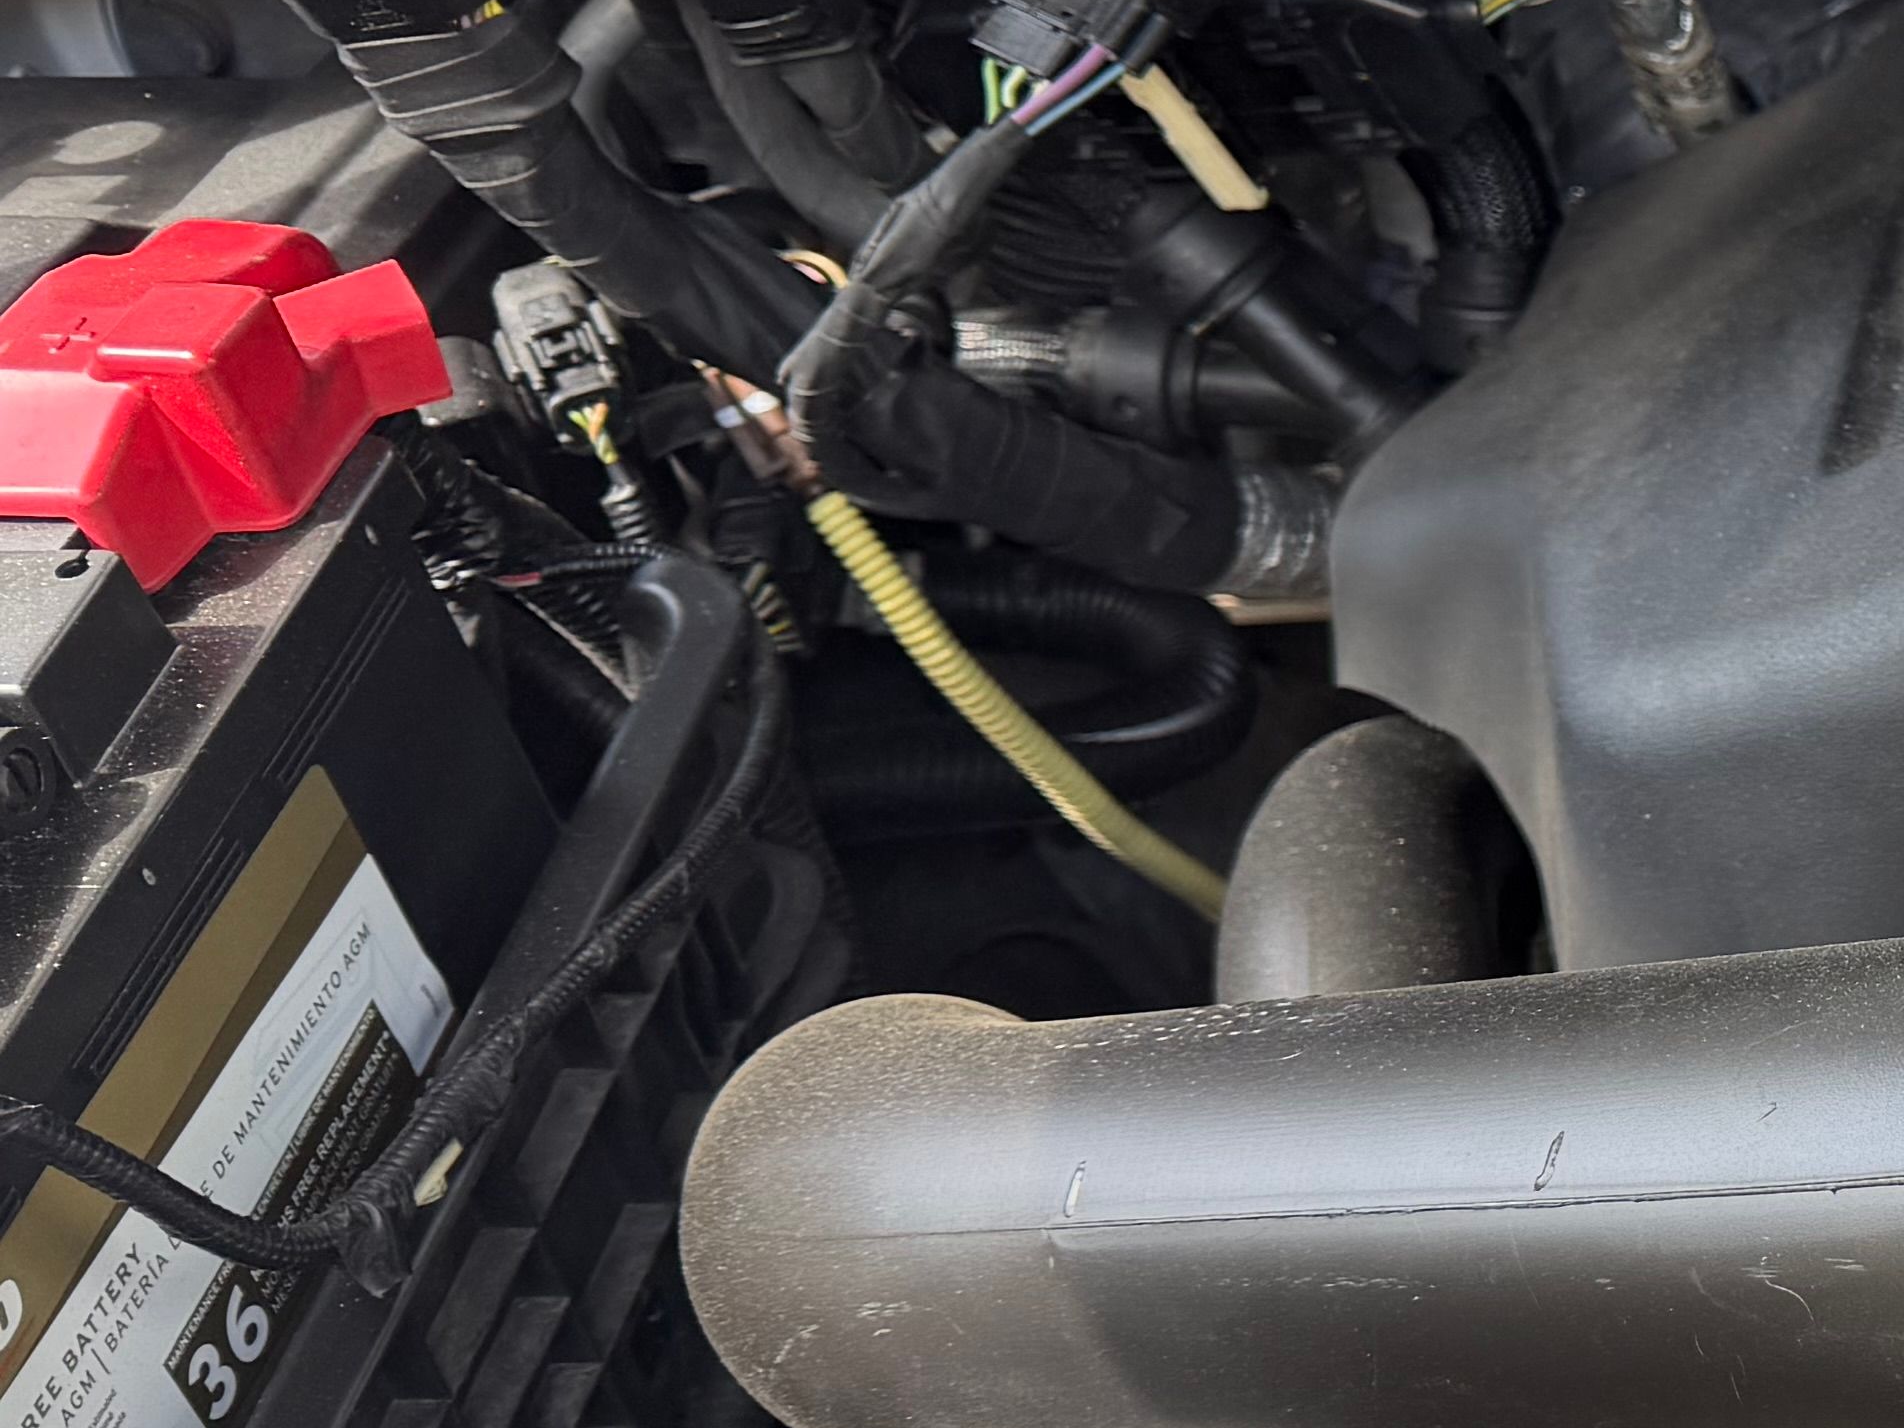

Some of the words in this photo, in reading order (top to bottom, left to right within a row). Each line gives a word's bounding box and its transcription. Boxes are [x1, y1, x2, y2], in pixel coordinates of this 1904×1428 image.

[61, 1369, 97, 1428] AGM
[104, 1253, 169, 1354] BATERÍA
[212, 1145, 235, 1179] DE
[233, 970, 342, 1145] MANTENIMIENTO
[343, 922, 372, 972] AGM
[62, 1242, 141, 1373] BATTERY
[188, 1284, 269, 1421] 36
